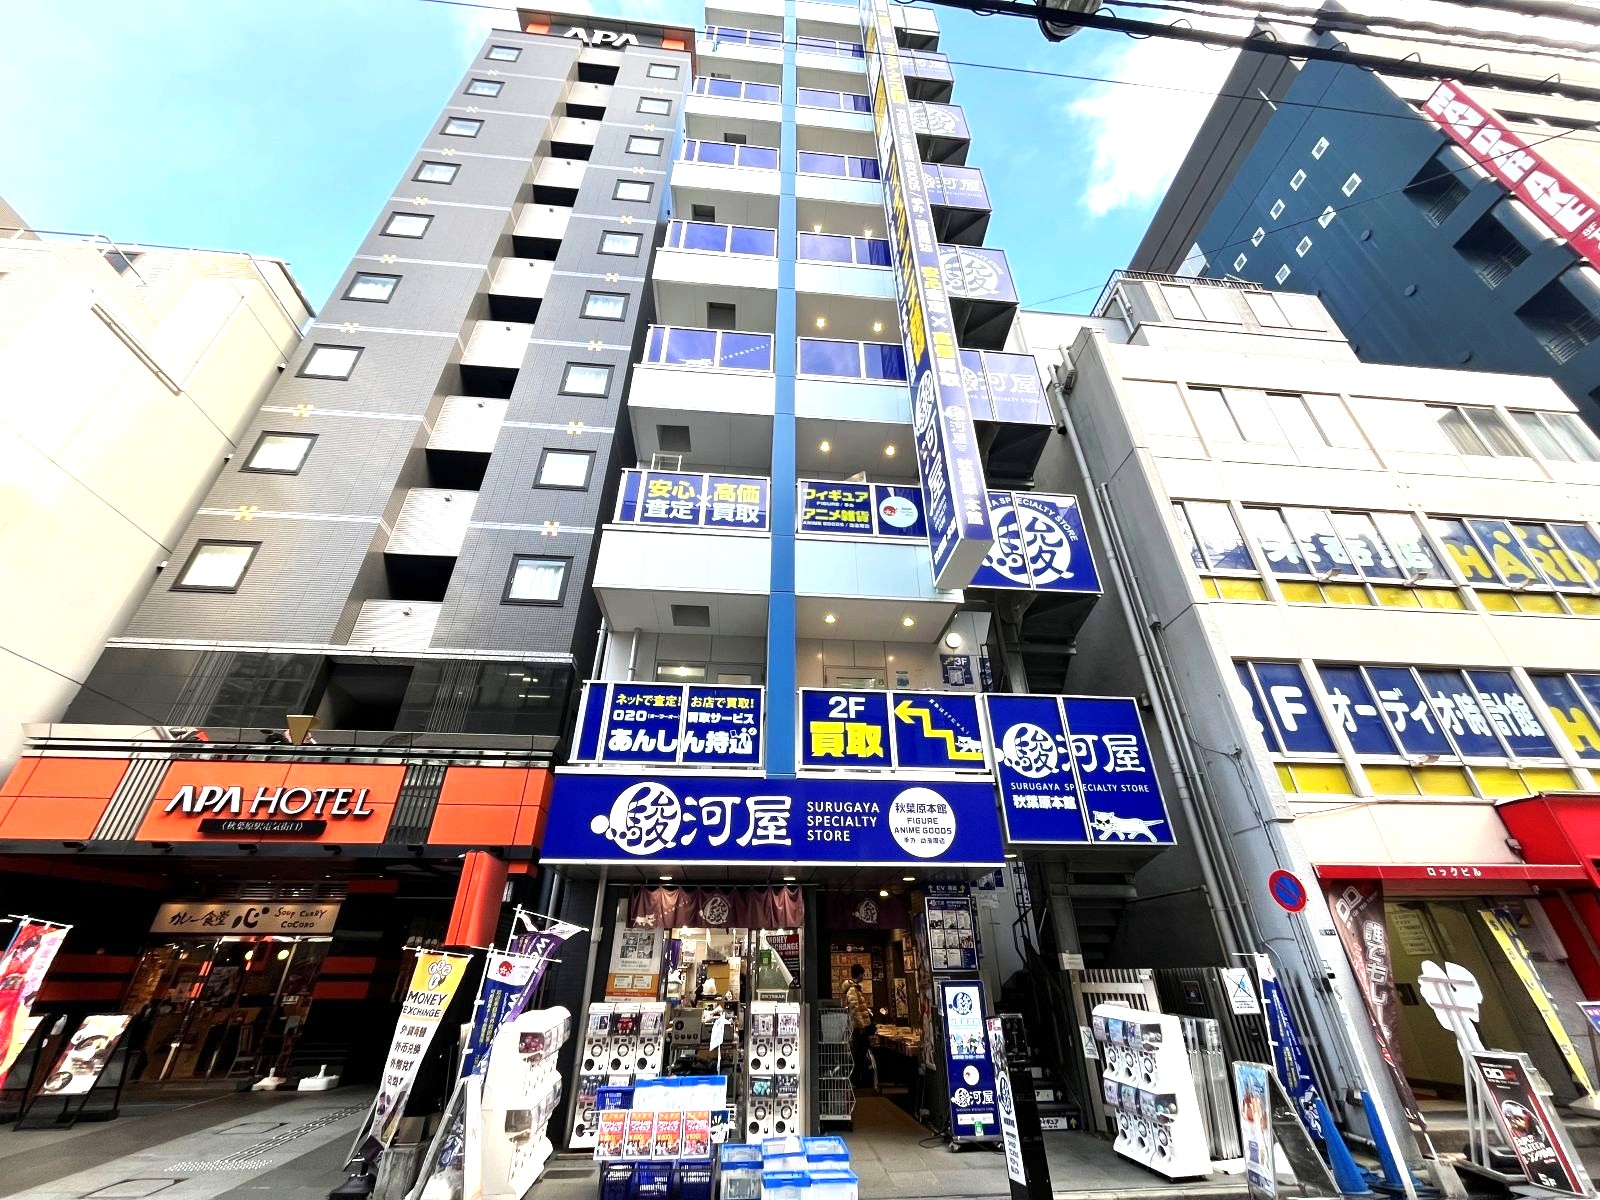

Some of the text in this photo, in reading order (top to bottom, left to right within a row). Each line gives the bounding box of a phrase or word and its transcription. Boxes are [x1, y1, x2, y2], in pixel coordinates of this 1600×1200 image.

[564, 27, 640, 49] APA
[648, 480, 696, 499] 安心
[714, 483, 760, 503] 高価
[644, 499, 694, 519] 査定
[711, 503, 759, 523] 買取
[828, 696, 866, 718] 2F
[810, 722, 884, 758] 買取
[1002, 722, 1146, 779] 駿河屋
[1010, 782, 1150, 793] SURUGAYA SPECIALTY STORE
[164, 785, 372, 816] APA HOTEL
[806, 801, 880, 813] SURUGAYA
[605, 781, 792, 855] 駿河屋
[806, 815, 877, 828] SPECIALTY
[906, 817, 939, 825] FIGURE
[806, 829, 851, 842] STORE
[922, 827, 952, 835] GOODS
[169, 910, 231, 926] カレー食堂
[407, 990, 448, 1006] MONEY
[402, 1004, 442, 1018] EXCHANGE
